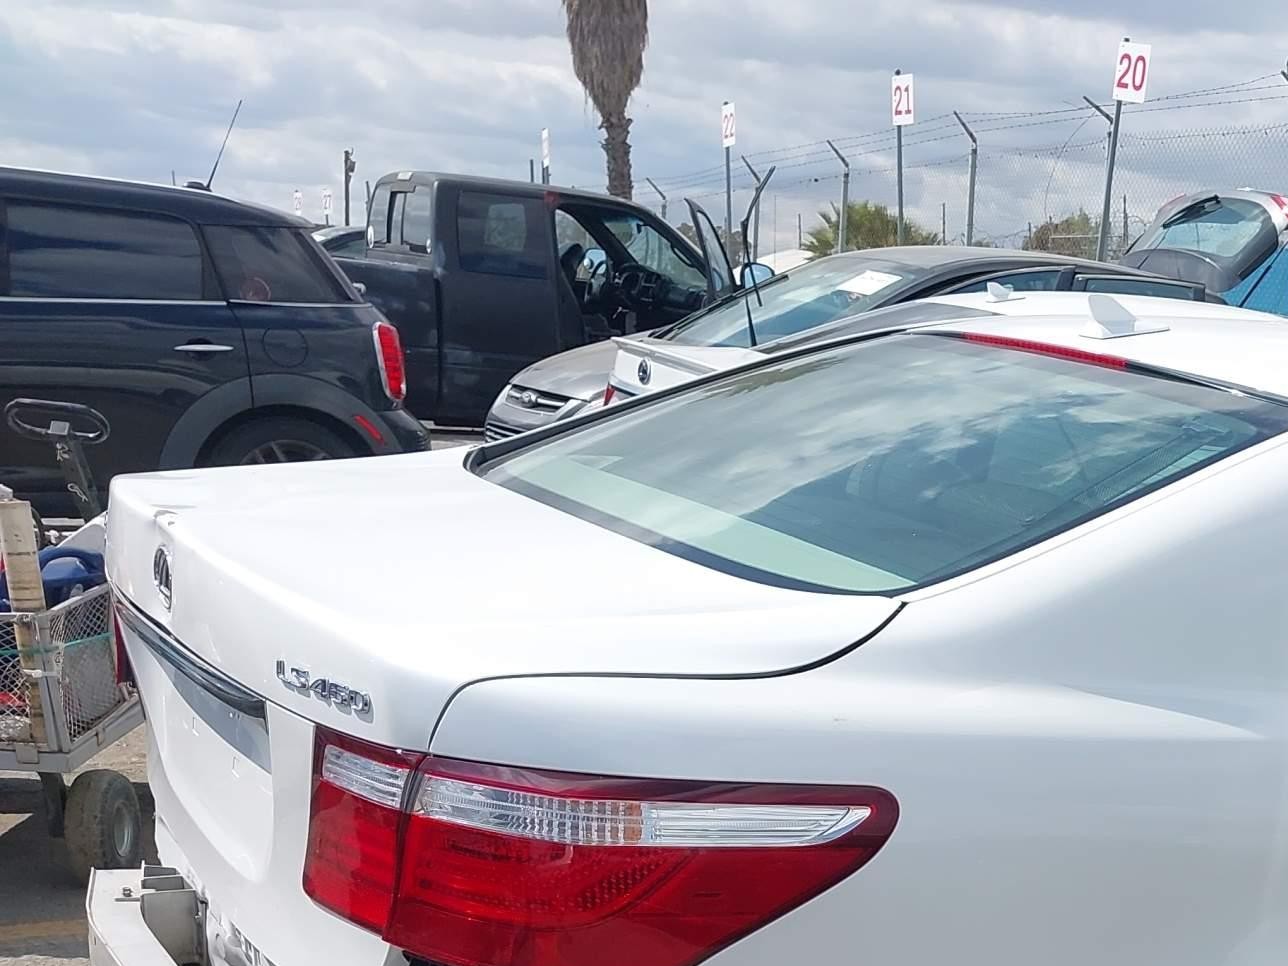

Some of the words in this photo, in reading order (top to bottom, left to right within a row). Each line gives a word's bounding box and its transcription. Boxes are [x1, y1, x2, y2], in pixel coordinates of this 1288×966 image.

[1116, 53, 1147, 92] 20
[893, 84, 912, 116] 21
[723, 112, 735, 139] 22
